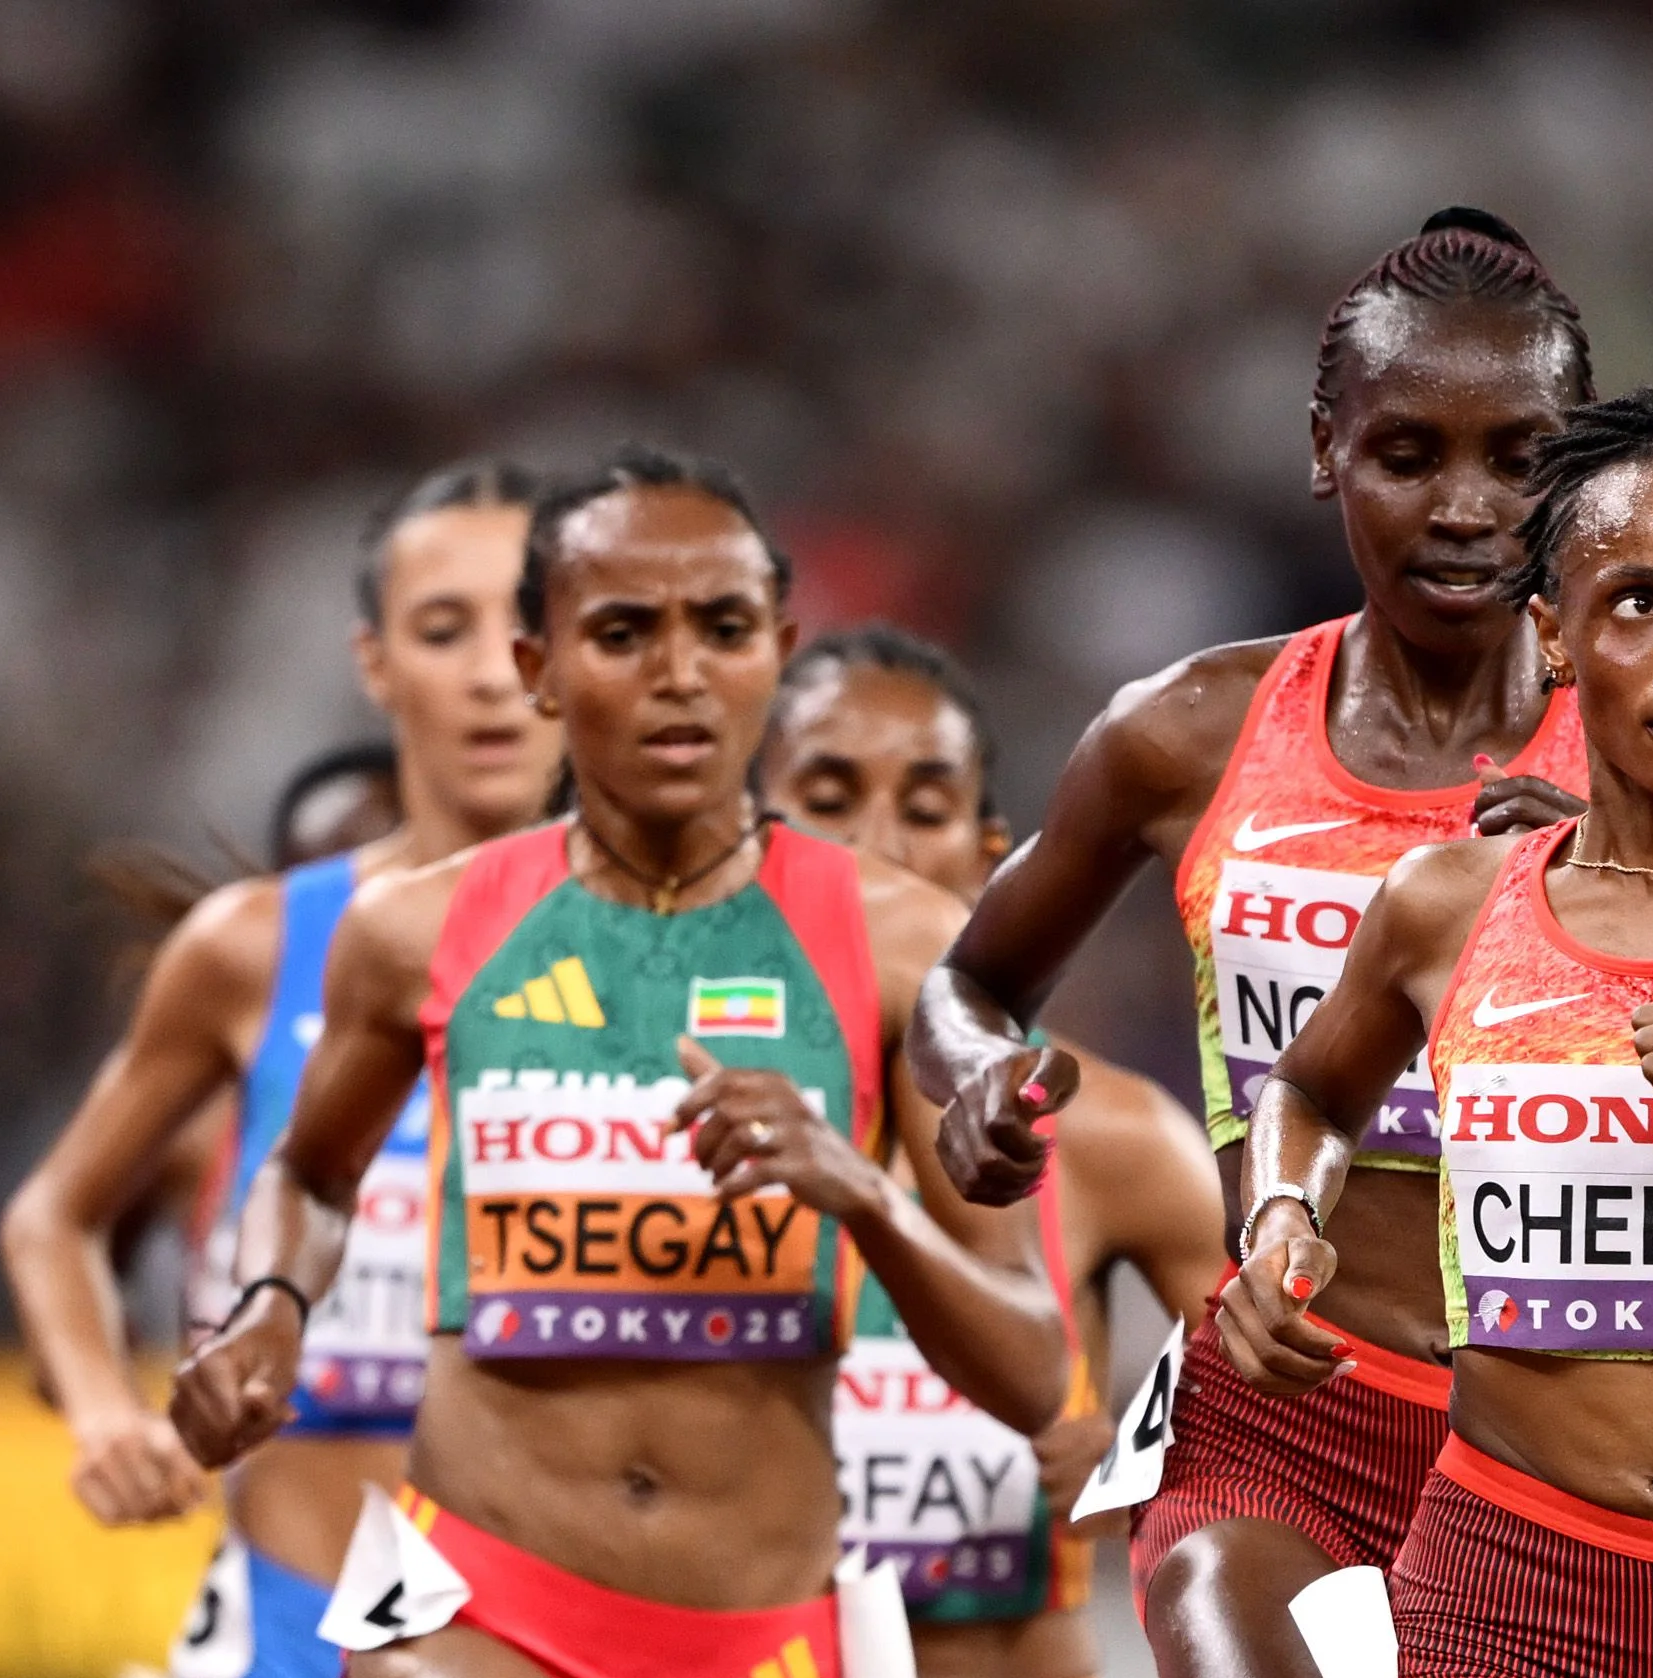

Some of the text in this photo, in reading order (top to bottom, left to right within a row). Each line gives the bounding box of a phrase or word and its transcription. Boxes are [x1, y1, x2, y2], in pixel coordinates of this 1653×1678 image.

[472, 1115, 701, 1163] HON
[482, 1198, 802, 1278] TSEGAY
[838, 1453, 1016, 1527] FAY
